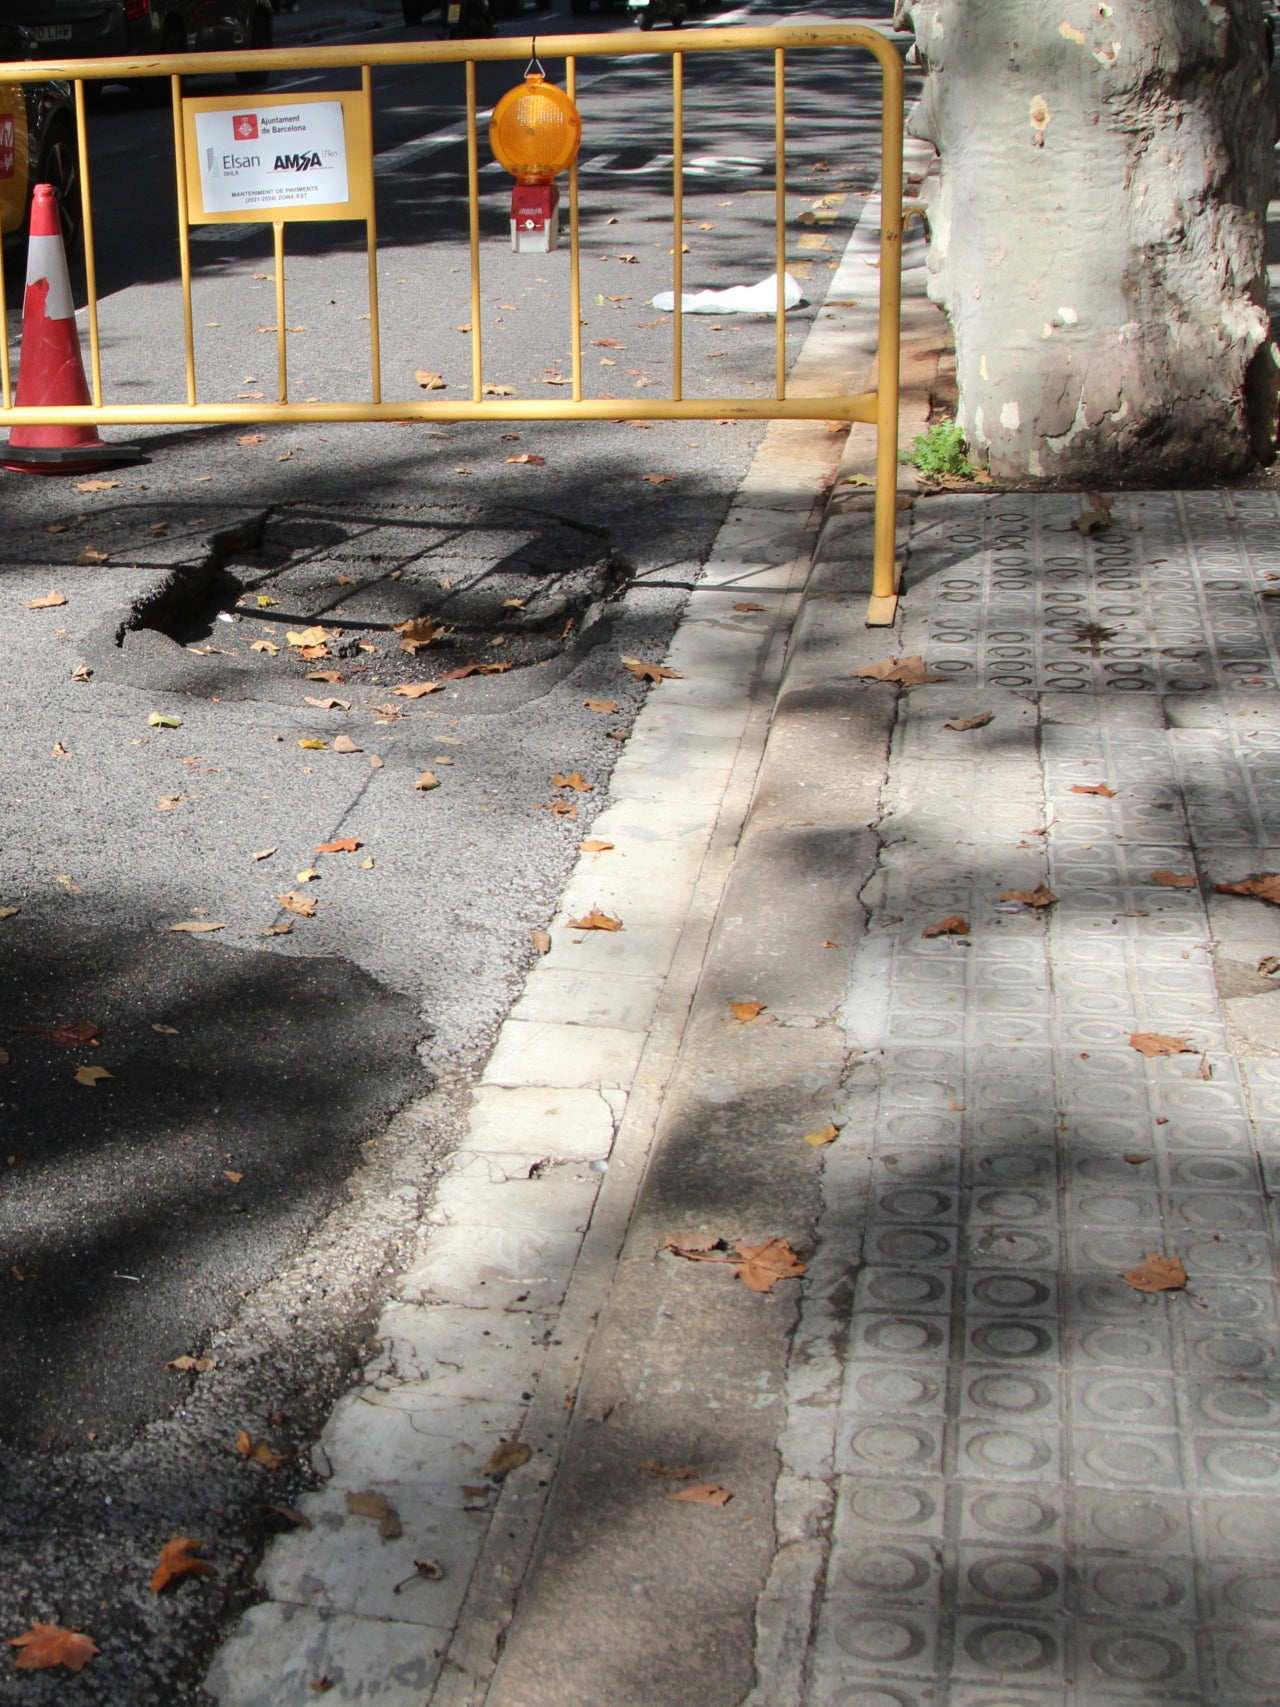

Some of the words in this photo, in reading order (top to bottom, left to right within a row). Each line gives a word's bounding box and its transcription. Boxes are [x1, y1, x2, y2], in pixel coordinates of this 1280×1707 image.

[261, 115, 300, 126] Ajuntament
[272, 124, 307, 133] Barcelona
[223, 153, 260, 169] Elsan
[232, 189, 274, 198] MANTENIMENT
